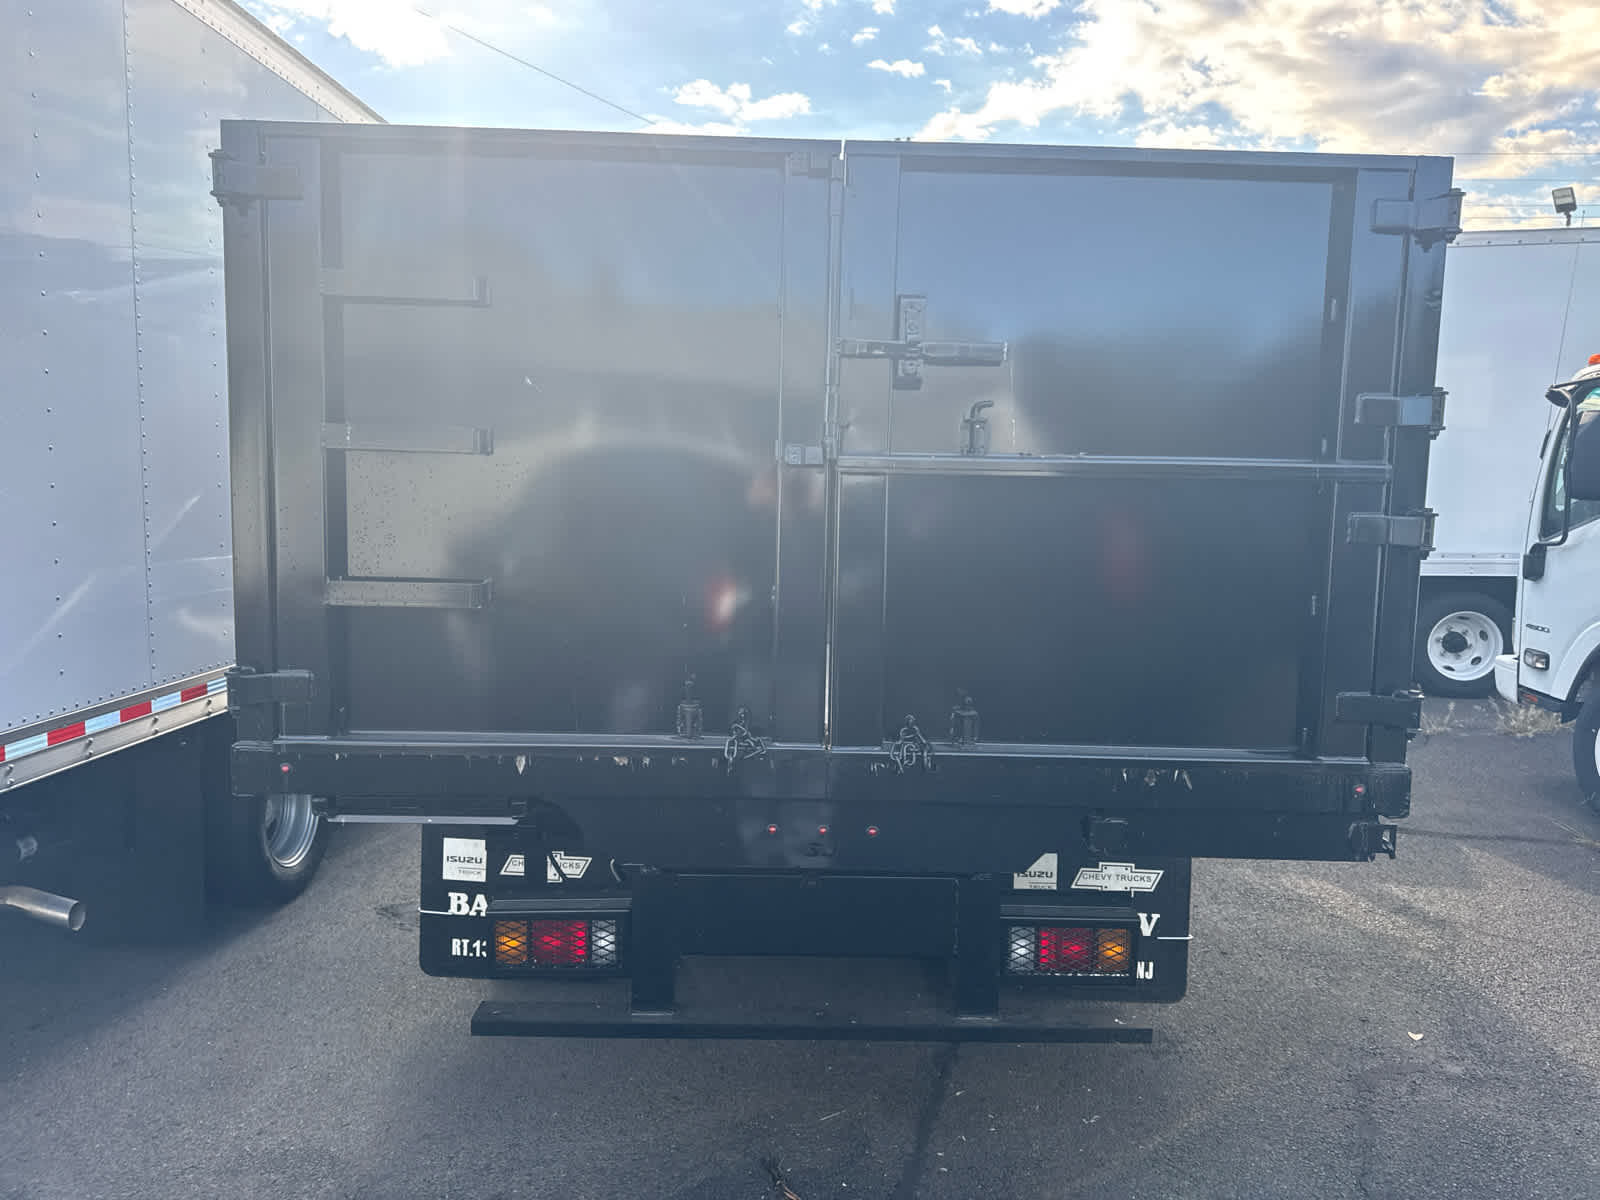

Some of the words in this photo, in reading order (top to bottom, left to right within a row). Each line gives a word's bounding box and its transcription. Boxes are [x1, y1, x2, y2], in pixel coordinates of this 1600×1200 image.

[446, 855, 483, 864] ISUZU
[1082, 873, 1112, 881] CHEVY
[1115, 874, 1152, 882] TRUCKS
[448, 892, 488, 916] BA
[1137, 912, 1161, 937] V
[1136, 961, 1154, 979] NJ
